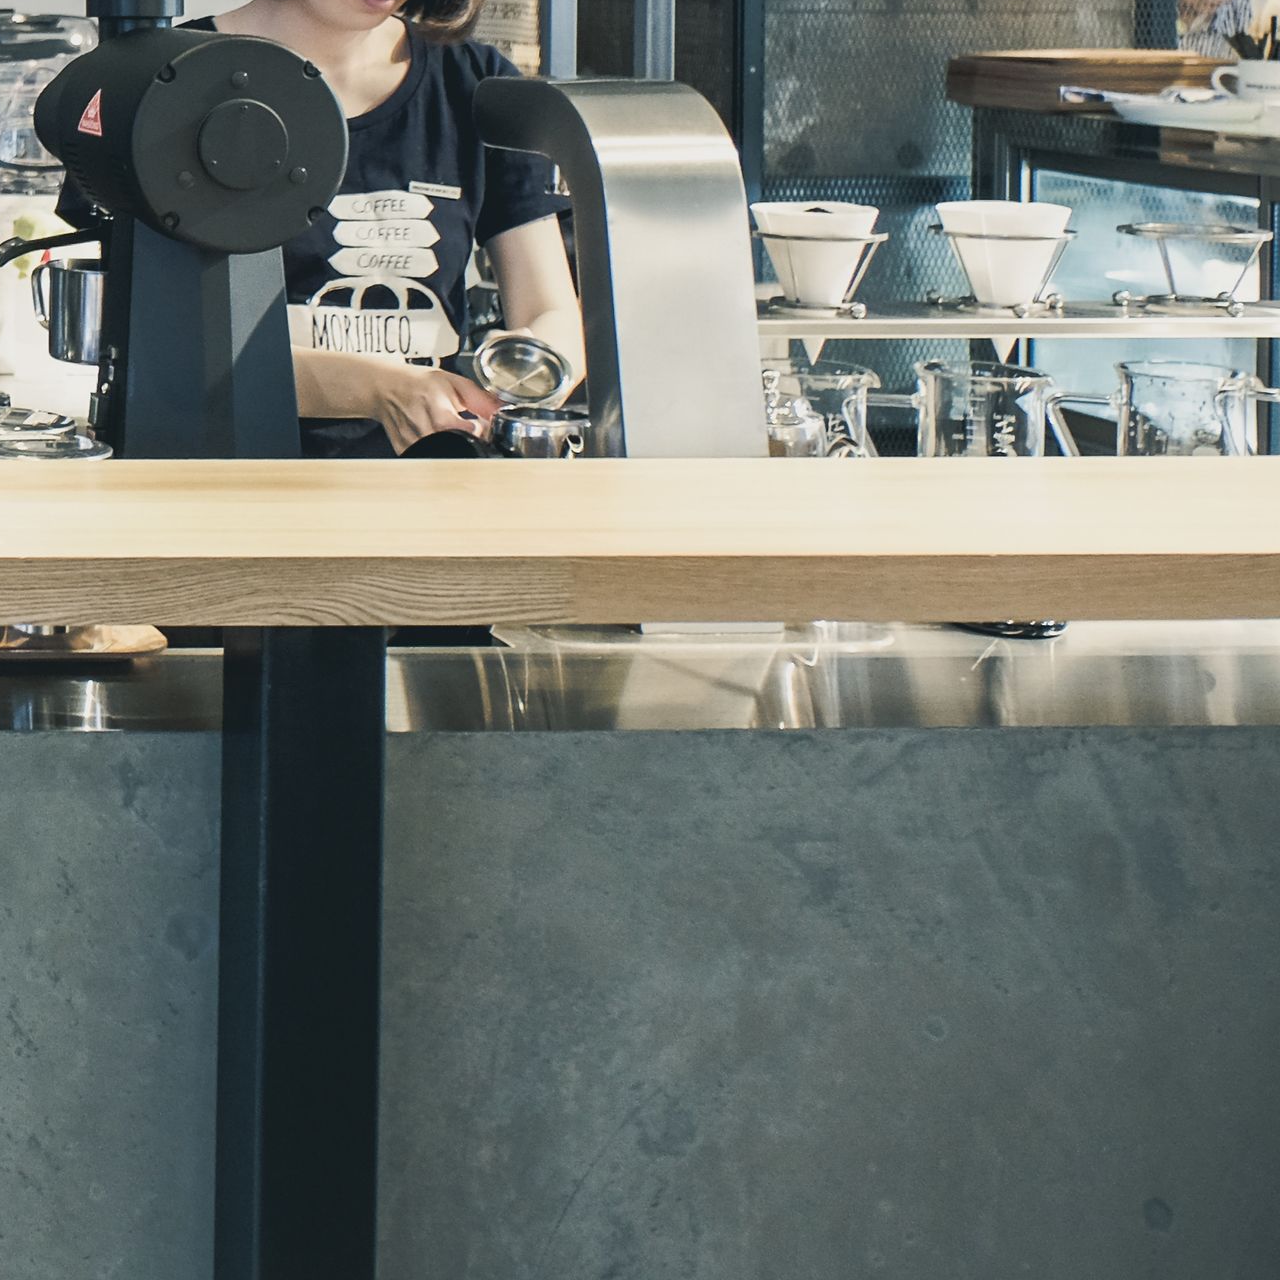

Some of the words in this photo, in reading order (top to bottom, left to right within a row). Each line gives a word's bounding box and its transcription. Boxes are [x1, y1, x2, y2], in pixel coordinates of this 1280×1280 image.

[352, 199, 406, 213] COFFEE
[355, 227, 411, 241] COFFEE
[356, 253, 414, 269] COFFEE
